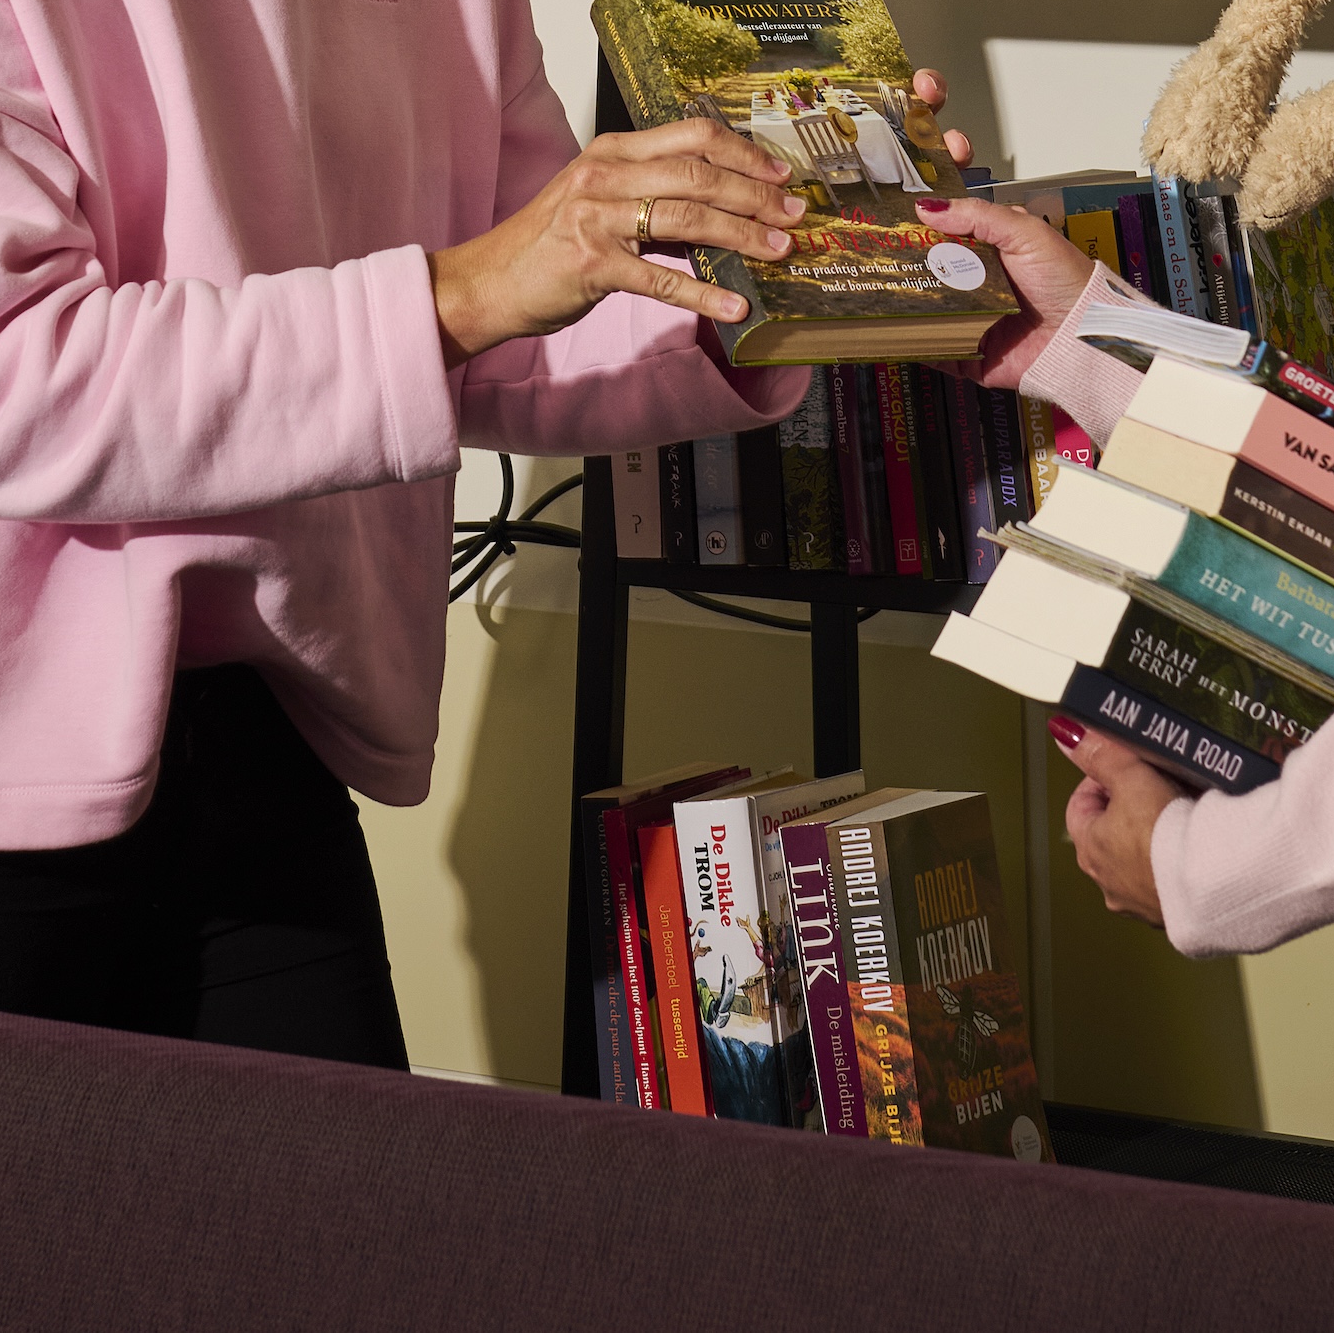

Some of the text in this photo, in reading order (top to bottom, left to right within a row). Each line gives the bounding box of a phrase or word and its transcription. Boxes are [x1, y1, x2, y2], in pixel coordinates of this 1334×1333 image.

[696, 3, 833, 20] DRINKWATER
[736, 22, 805, 31] Bestsellerauteur
[760, 32, 809, 44] De olijfgaard
[604, 10, 650, 119] CAROL DRINKWATER
[841, 206, 876, 226] De
[789, 260, 923, 279] Een prachtig verhaal over
[1167, 227, 1185, 273] en de
[821, 276, 943, 292] oude bomen en olijfolie
[1215, 274, 1228, 303] Altijd
[833, 376, 849, 444] Griezelbus
[1284, 432, 1317, 462] VAN
[669, 464, 682, 509] FRANK
[1234, 486, 1333, 549] KERSTIN EKMAN
[1198, 567, 1247, 605] HET
[1250, 596, 1295, 631] WIT
[1127, 647, 1189, 688] PERRY
[1130, 627, 1198, 674] SARAH
[1198, 675, 1228, 697] HET
[1099, 690, 1244, 781] AAN JAVA ROAD
[694, 843, 715, 912] TROM
[710, 824, 734, 927] De Dikke
[914, 858, 978, 930] ANDREJ
[659, 904, 680, 989] Jan Boerstoel
[838, 827, 894, 1013] ANDREJ KOERKOV
[916, 915, 993, 993] KOERKOV
[618, 882, 651, 1091] Het geheim van het doelpunt Hans
[608, 986, 622, 1057] die de paus
[670, 998, 689, 1060] tussentijd
[826, 1005, 856, 1129] De misleiding
[875, 1024, 897, 1096] GRIJZE
[948, 1065, 1005, 1102] GRIJZE
[956, 1089, 1005, 1125] BIJEN
